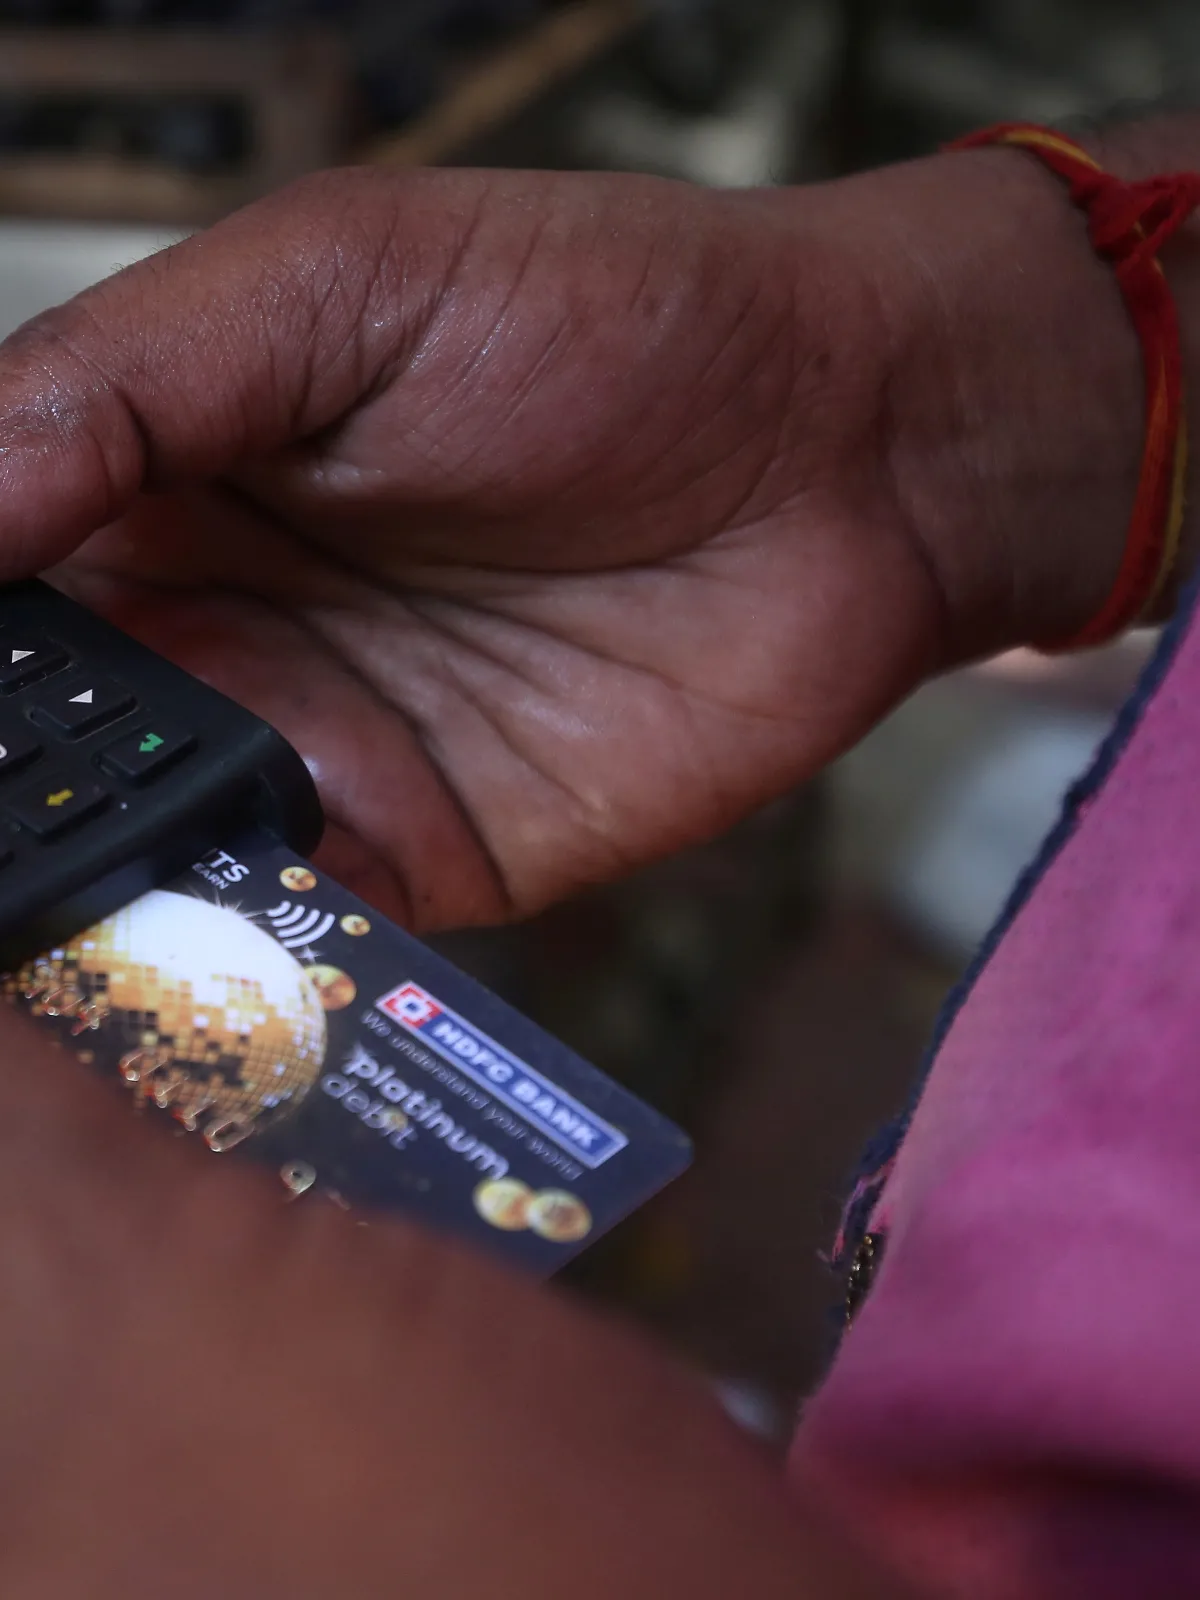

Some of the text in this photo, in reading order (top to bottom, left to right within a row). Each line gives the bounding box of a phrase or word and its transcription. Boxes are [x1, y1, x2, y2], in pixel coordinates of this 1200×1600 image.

[320, 1072, 418, 1150] debit
[341, 1048, 509, 1180] platinum
[361, 1010, 584, 1181] We understand your world
[432, 1021, 599, 1148] HDFC BANK
